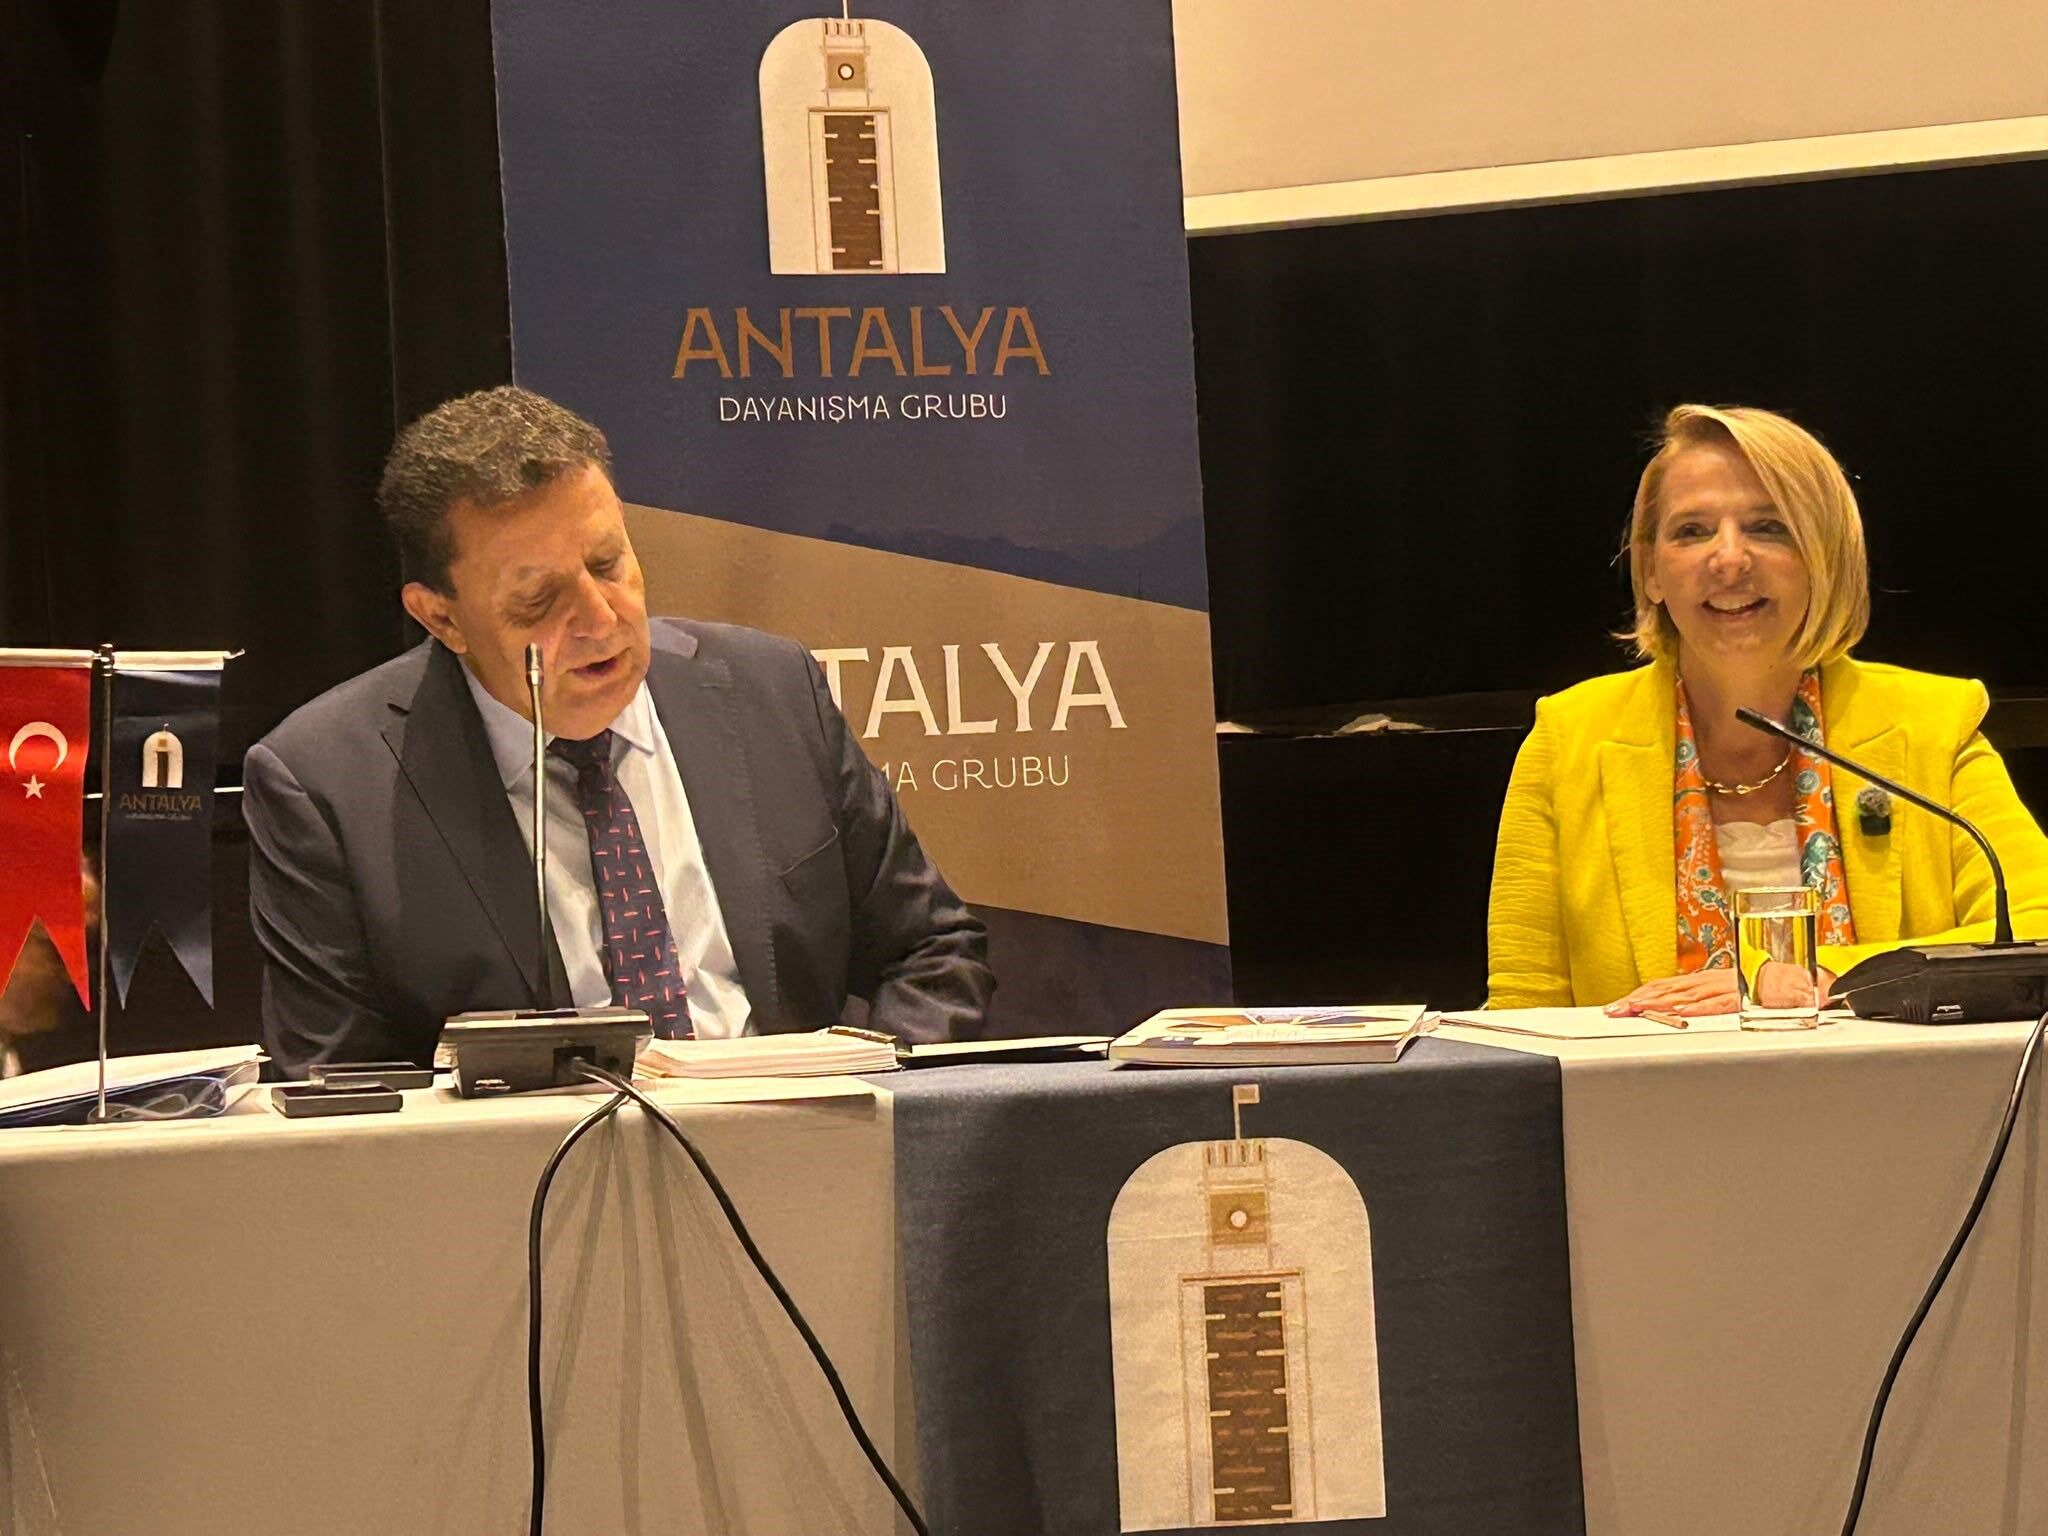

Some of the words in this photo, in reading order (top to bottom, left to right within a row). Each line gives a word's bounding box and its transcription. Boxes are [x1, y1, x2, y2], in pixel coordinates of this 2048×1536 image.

[672, 305, 1051, 379] ANTALYA
[719, 395, 890, 424] DAYANIŞMA
[900, 394, 1007, 419] GRUBU
[810, 640, 1128, 739] TALYA
[932, 755, 1069, 791] GRUBU
[119, 793, 202, 811] ANTALYA
